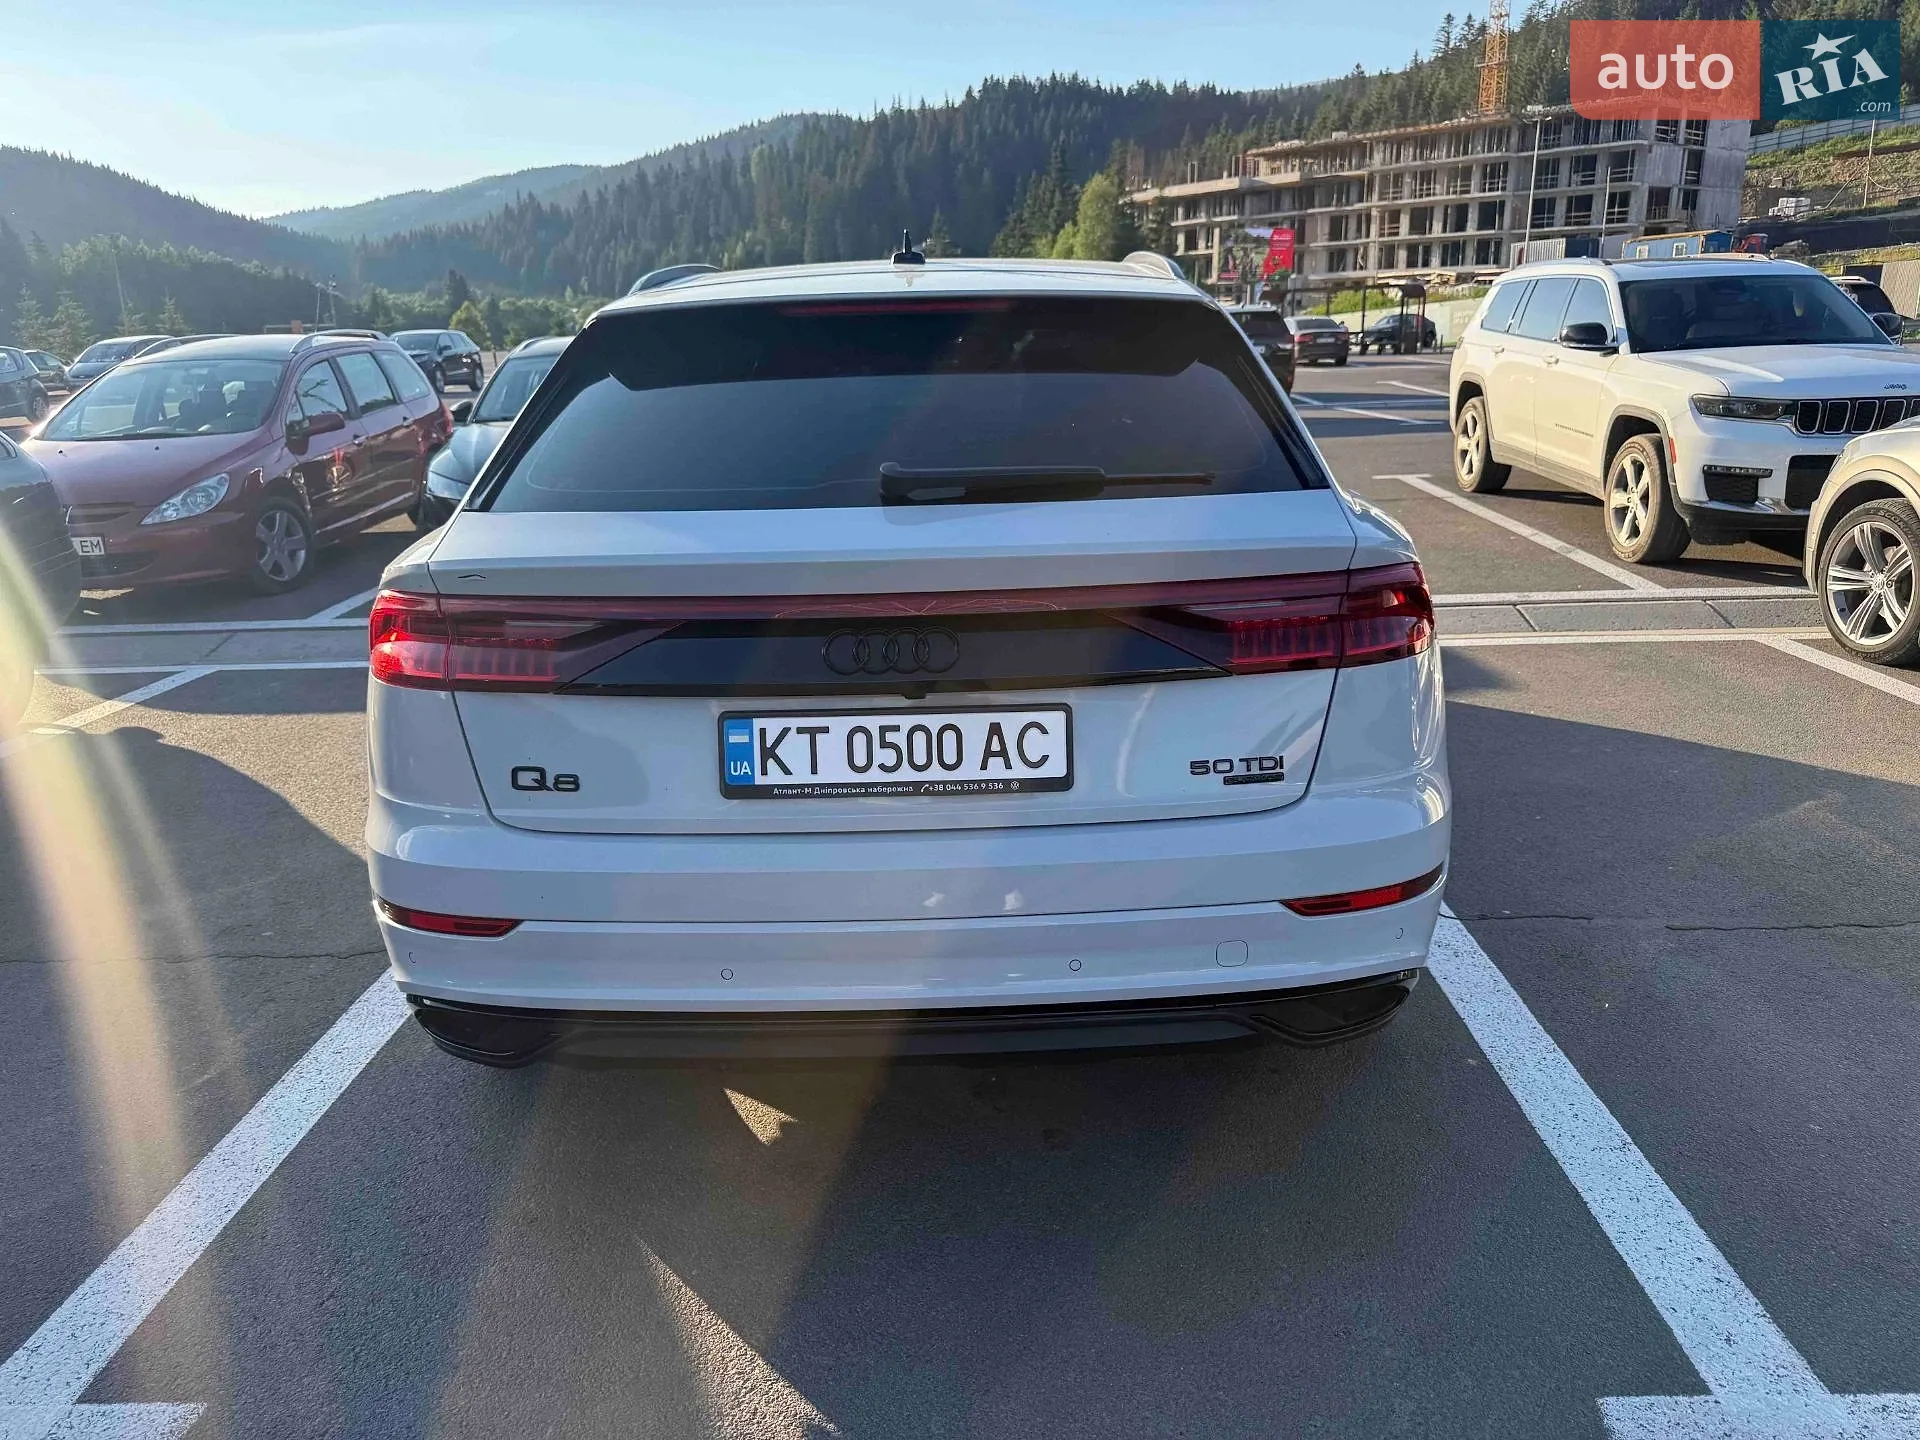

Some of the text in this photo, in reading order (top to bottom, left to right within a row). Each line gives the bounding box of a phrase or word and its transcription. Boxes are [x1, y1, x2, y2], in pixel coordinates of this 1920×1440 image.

[80, 540, 102, 553] EM
[759, 720, 1050, 776] KT 0500 AC
[730, 760, 752, 776] UA
[1190, 755, 1284, 775] 50 TDI
[511, 765, 580, 792] Q8
[773, 787, 812, 795] Атлант-М
[814, 786, 866, 796] Дніпровська
[867, 785, 914, 794] набережна
[946, 783, 962, 791] 044
[980, 782, 986, 790] 9
[988, 782, 1004, 790] 536
